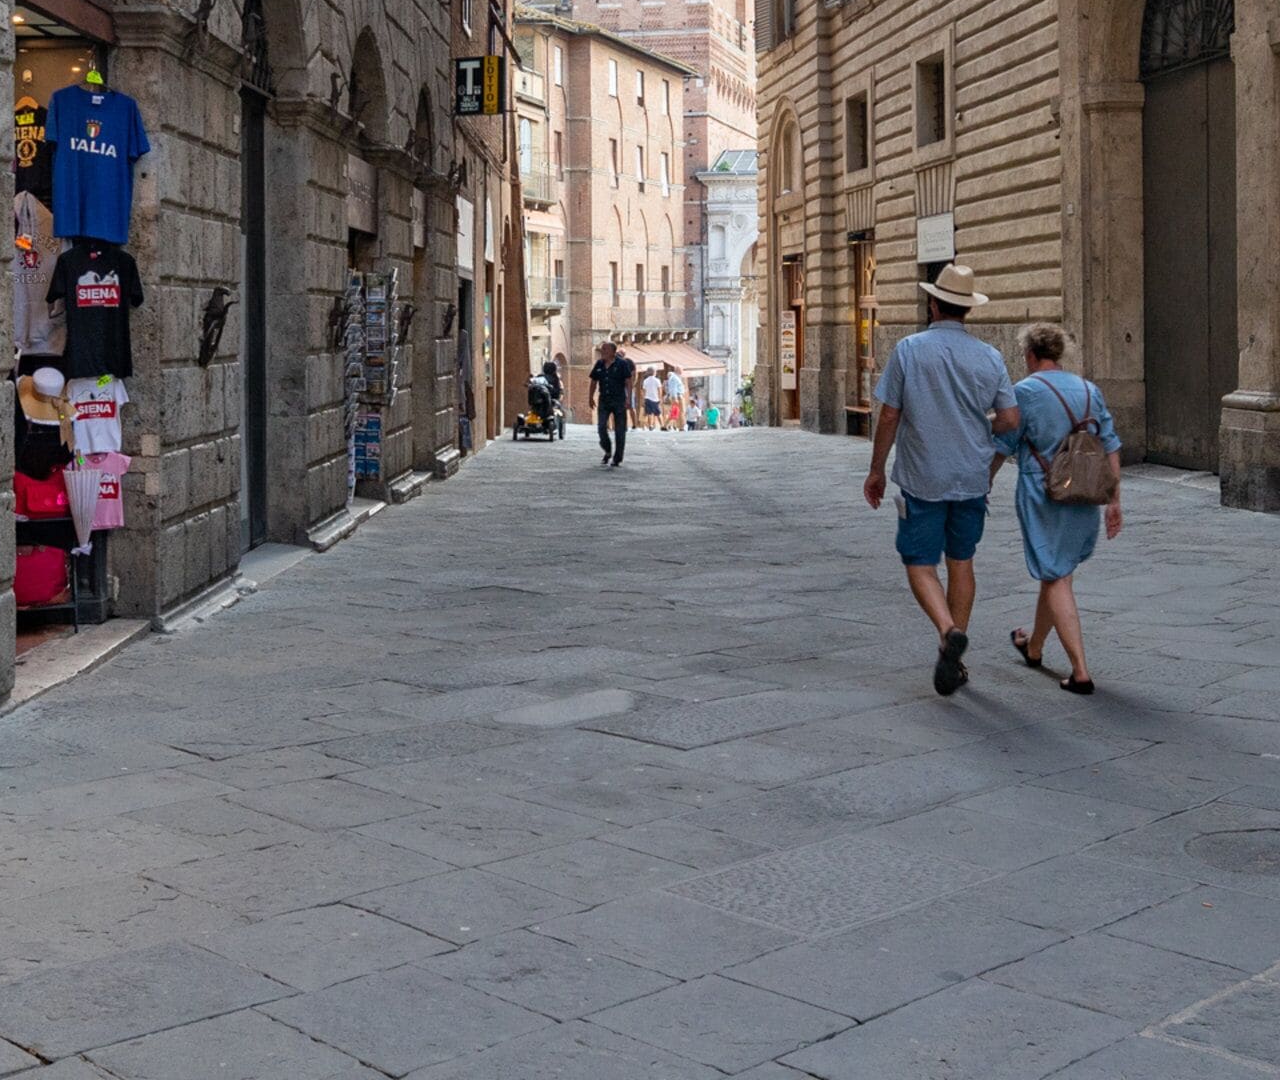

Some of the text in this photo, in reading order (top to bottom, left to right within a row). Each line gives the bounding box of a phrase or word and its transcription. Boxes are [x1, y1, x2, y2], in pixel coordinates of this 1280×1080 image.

[459, 60, 480, 95] T
[486, 57, 495, 102] LOTTO
[79, 288, 118, 299] SIENA
[78, 404, 111, 415] SIENA
